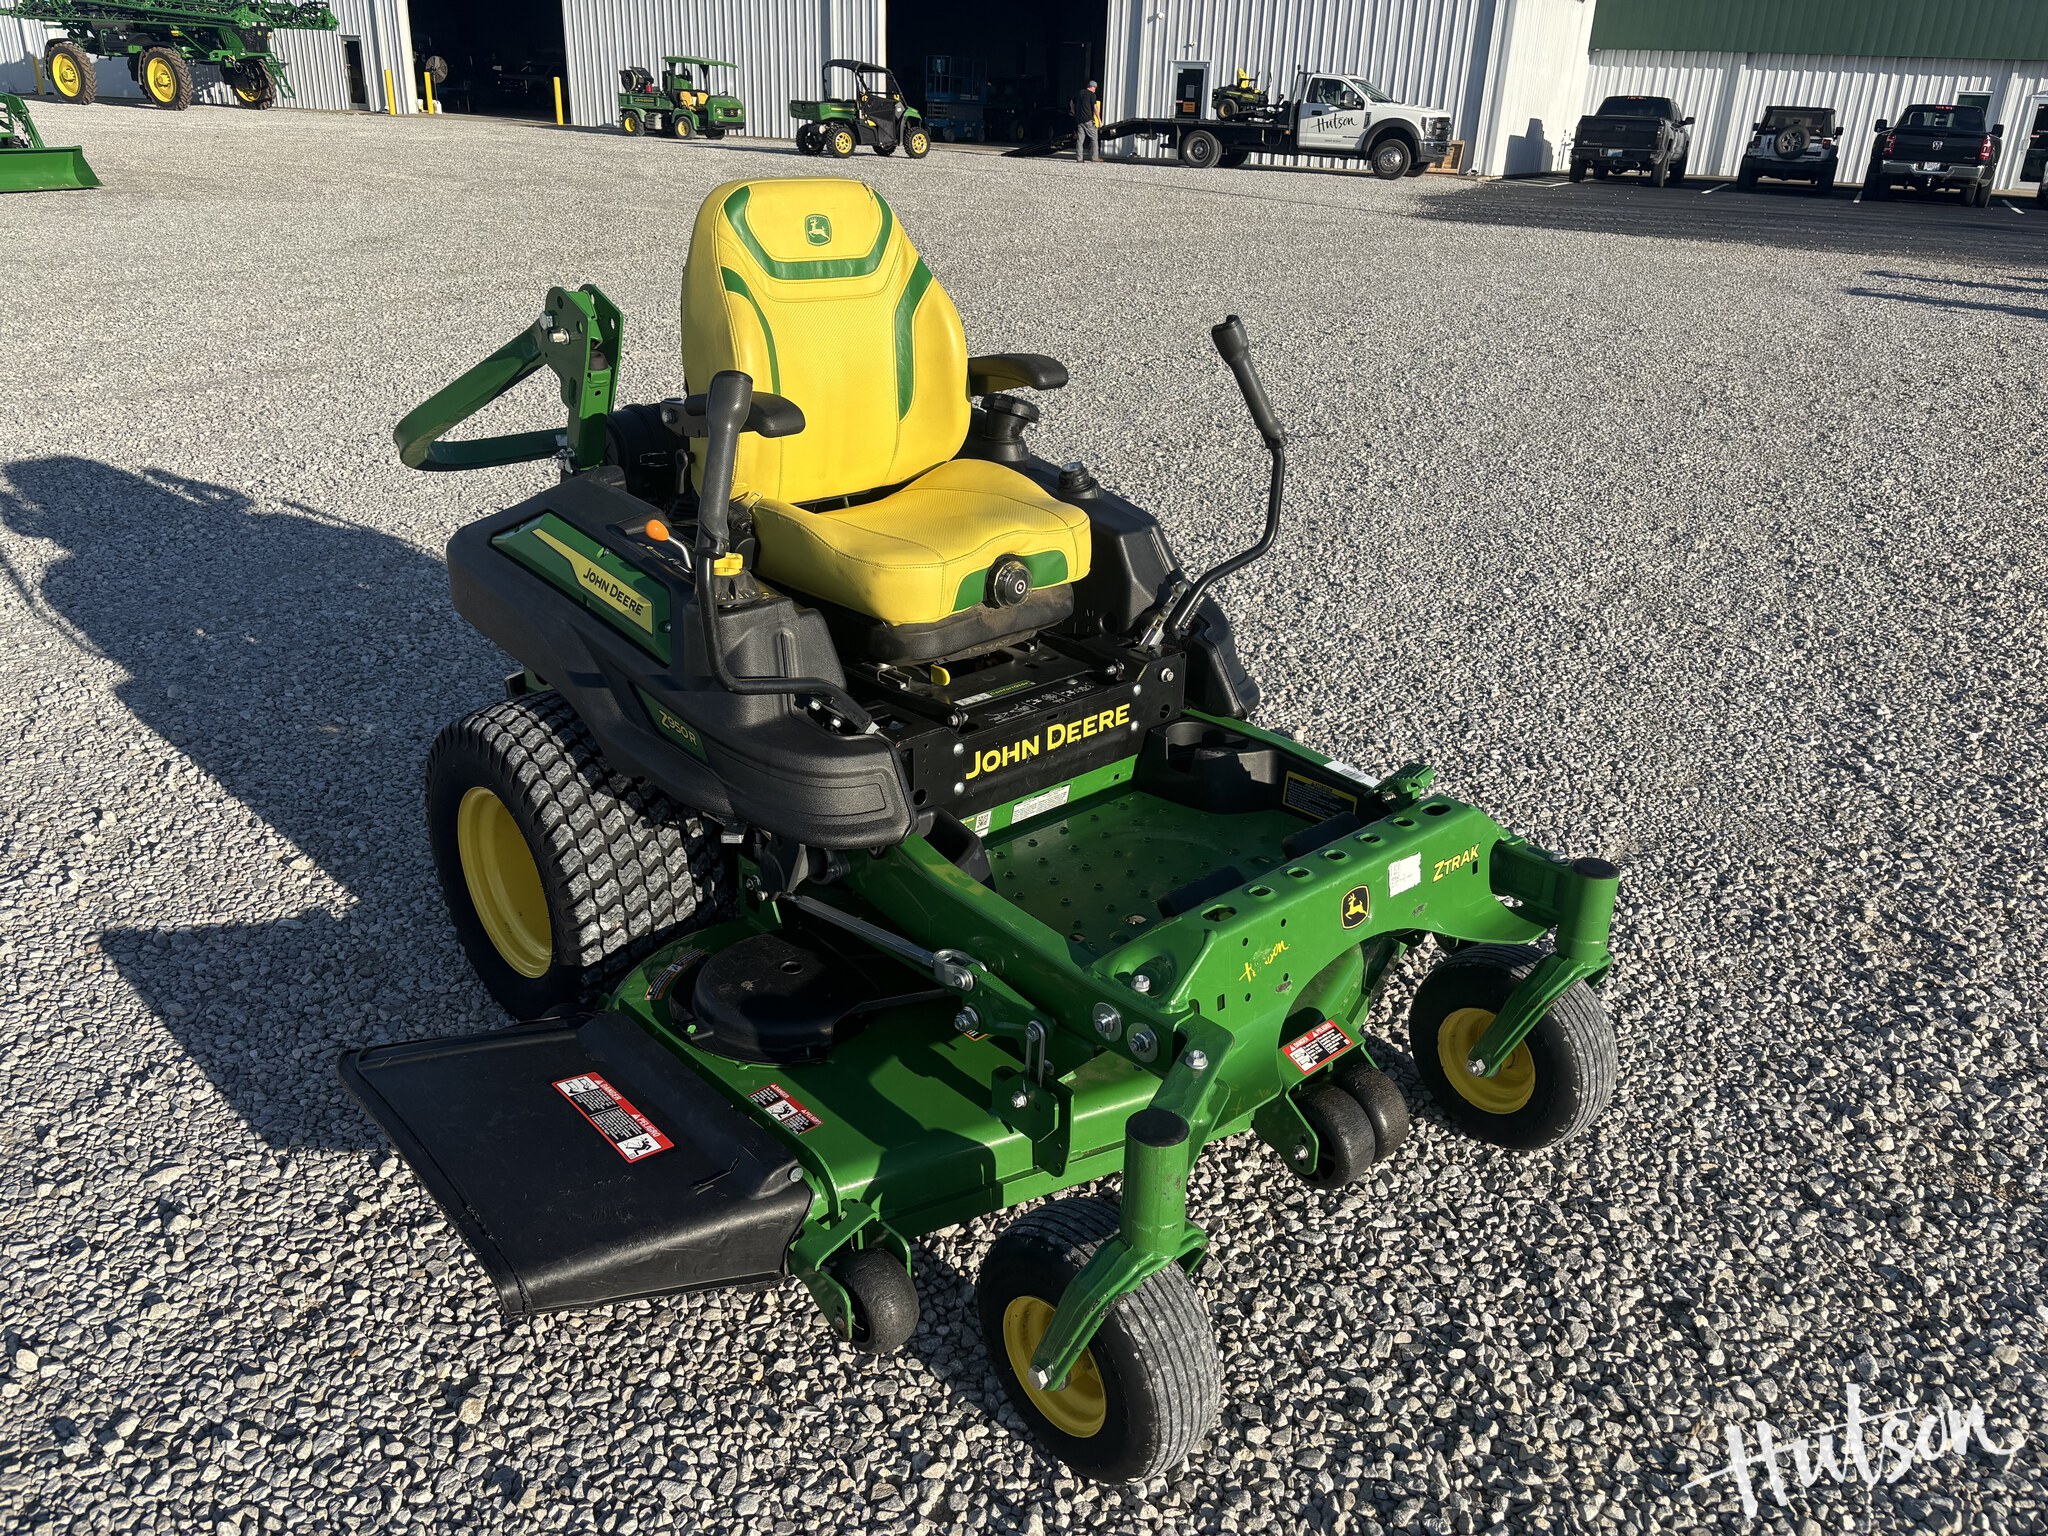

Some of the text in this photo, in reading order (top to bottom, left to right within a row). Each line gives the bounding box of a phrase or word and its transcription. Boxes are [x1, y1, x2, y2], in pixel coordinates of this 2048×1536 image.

[1310, 113, 1359, 133] Hutson
[583, 568, 644, 616] JOHN DEERE
[966, 703, 1131, 780] JOHN DEERE
[1432, 842, 1481, 884] ZTRAK
[600, 1083, 622, 1101] DANGER
[637, 1118, 661, 1138] PELIGRO
